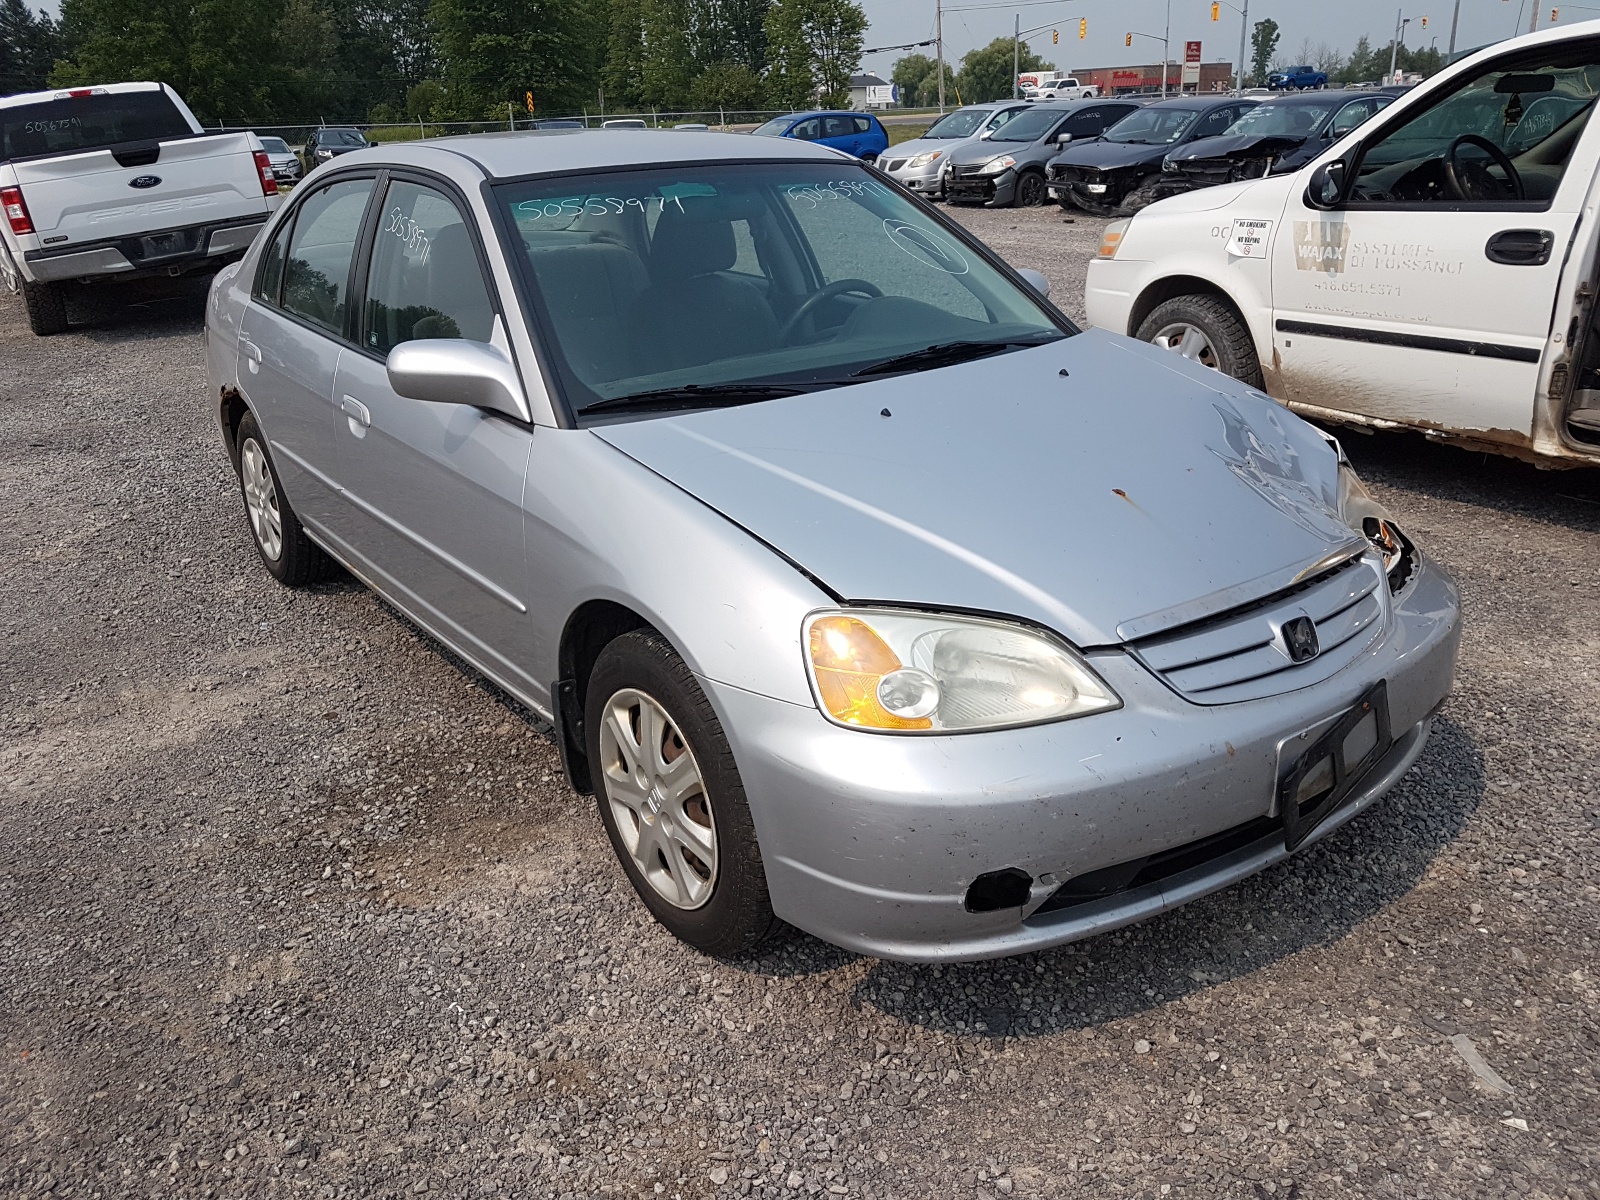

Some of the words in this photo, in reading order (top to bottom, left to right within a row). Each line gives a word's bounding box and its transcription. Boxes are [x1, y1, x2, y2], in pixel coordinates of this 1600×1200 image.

[25, 117, 82, 134] 50567591
[137, 176, 156, 187] Ford
[519, 196, 685, 221] 50558971
[385, 206, 431, 268] 50558971
[1298, 244, 1344, 262] WAJAX
